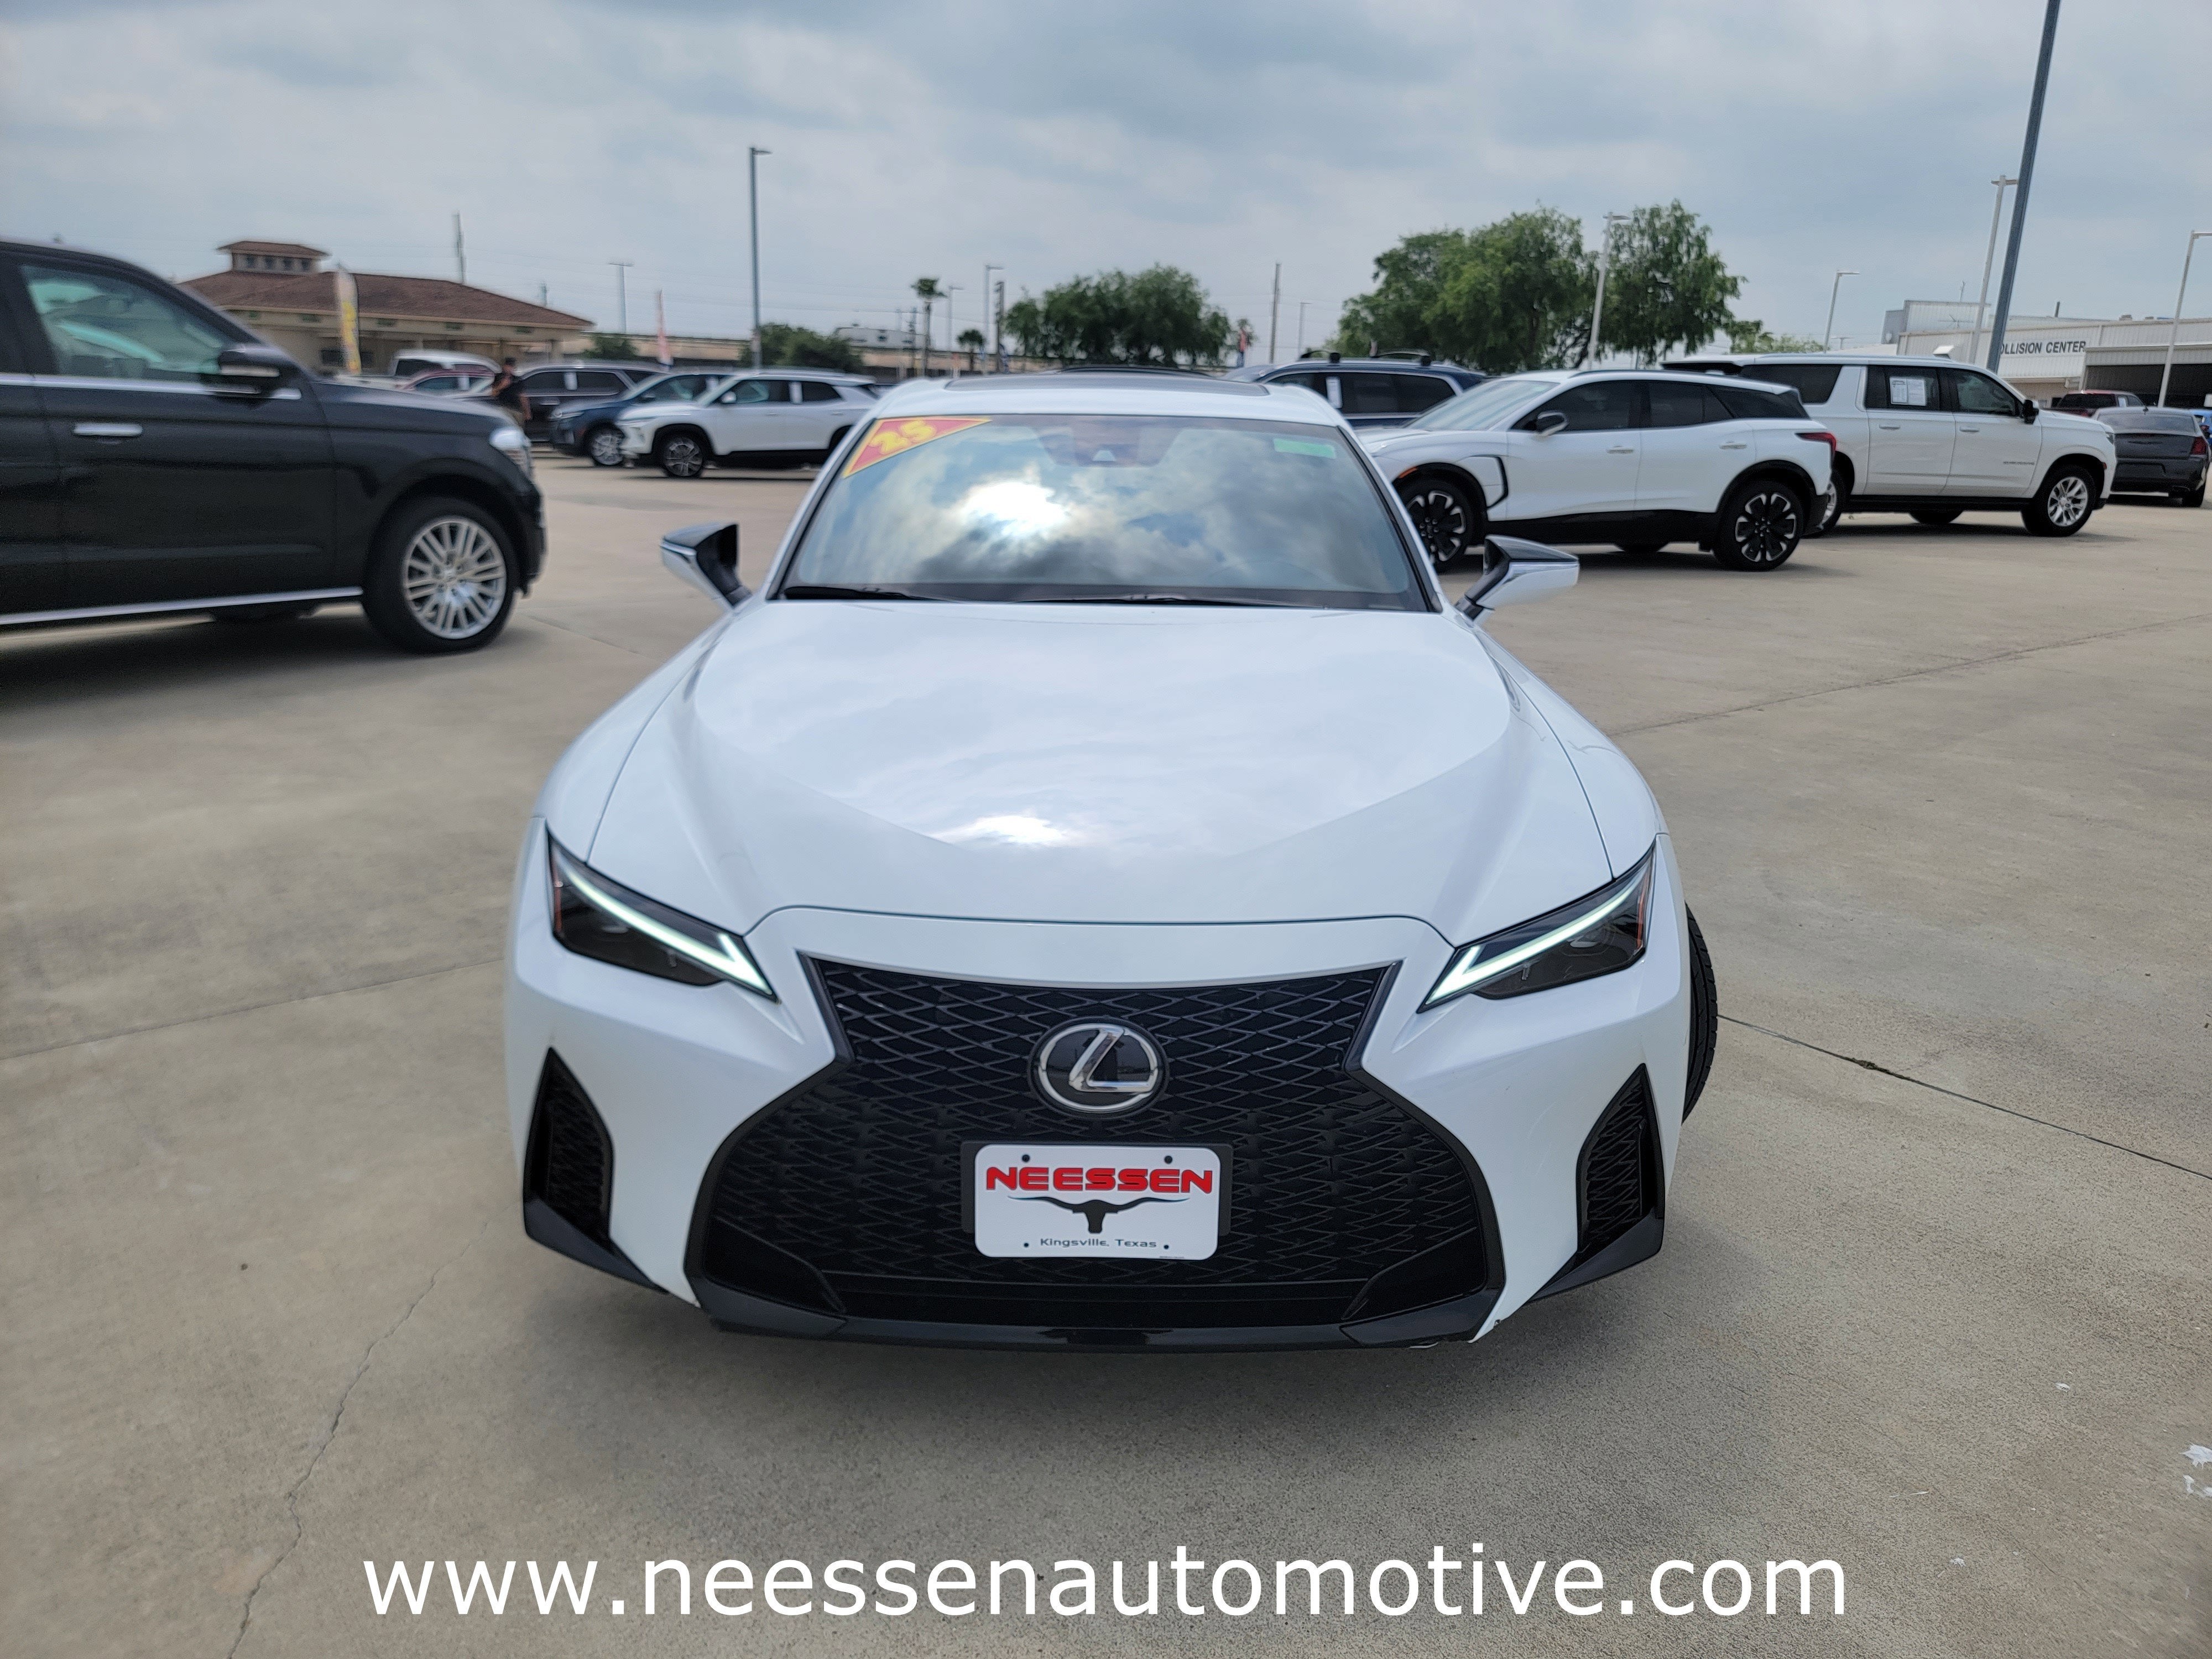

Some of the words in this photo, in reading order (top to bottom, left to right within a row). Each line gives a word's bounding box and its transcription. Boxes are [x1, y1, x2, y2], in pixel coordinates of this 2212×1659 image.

[2000, 342, 2042, 355] OLLISION
[2046, 340, 2086, 353] CENTER
[985, 1166, 1213, 1194] NEESSEN
[1114, 1239, 1157, 1248] Texas
